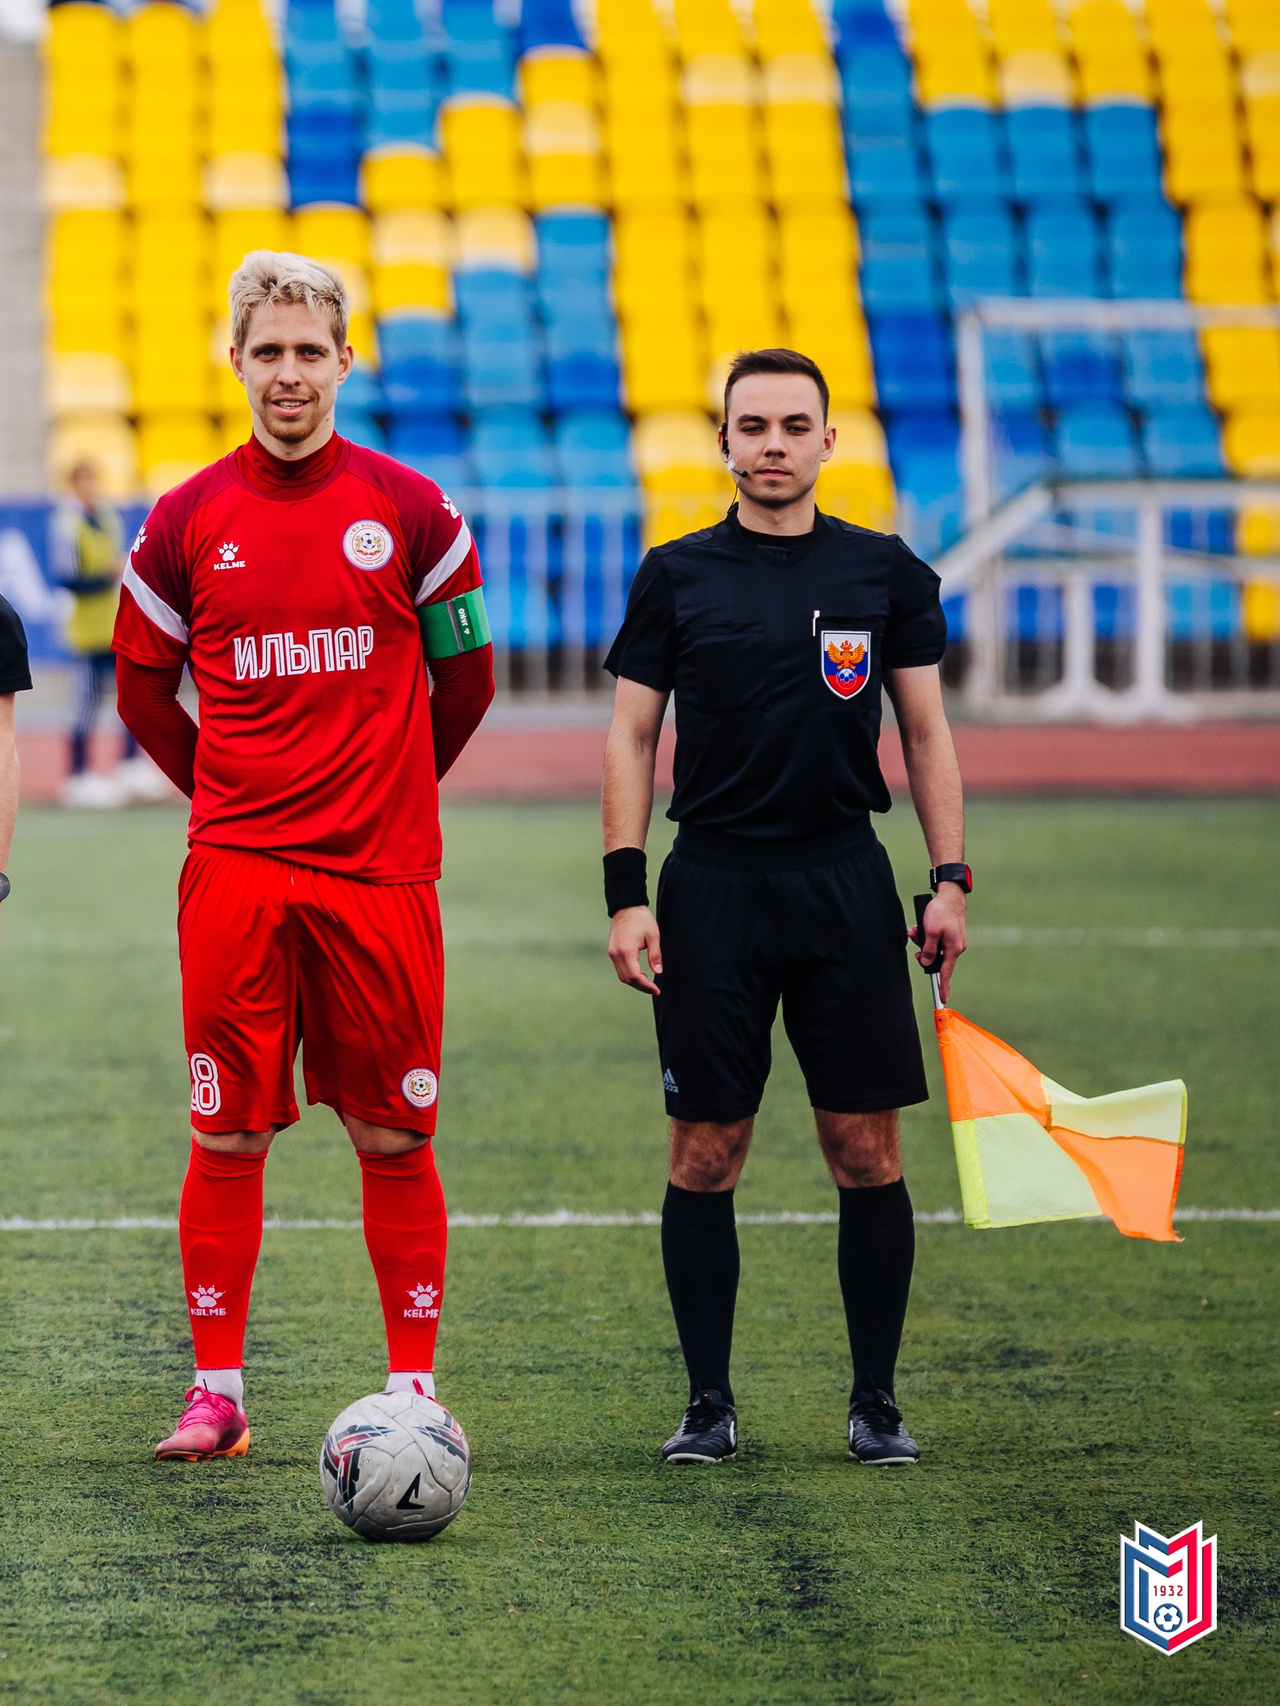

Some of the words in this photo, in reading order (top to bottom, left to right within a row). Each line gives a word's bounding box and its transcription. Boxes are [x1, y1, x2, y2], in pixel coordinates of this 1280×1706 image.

[213, 560, 246, 570] KELME
[233, 625, 374, 680] ИЛЬПАР
[191, 1053, 221, 1115] 8
[191, 1308, 226, 1316] KELME
